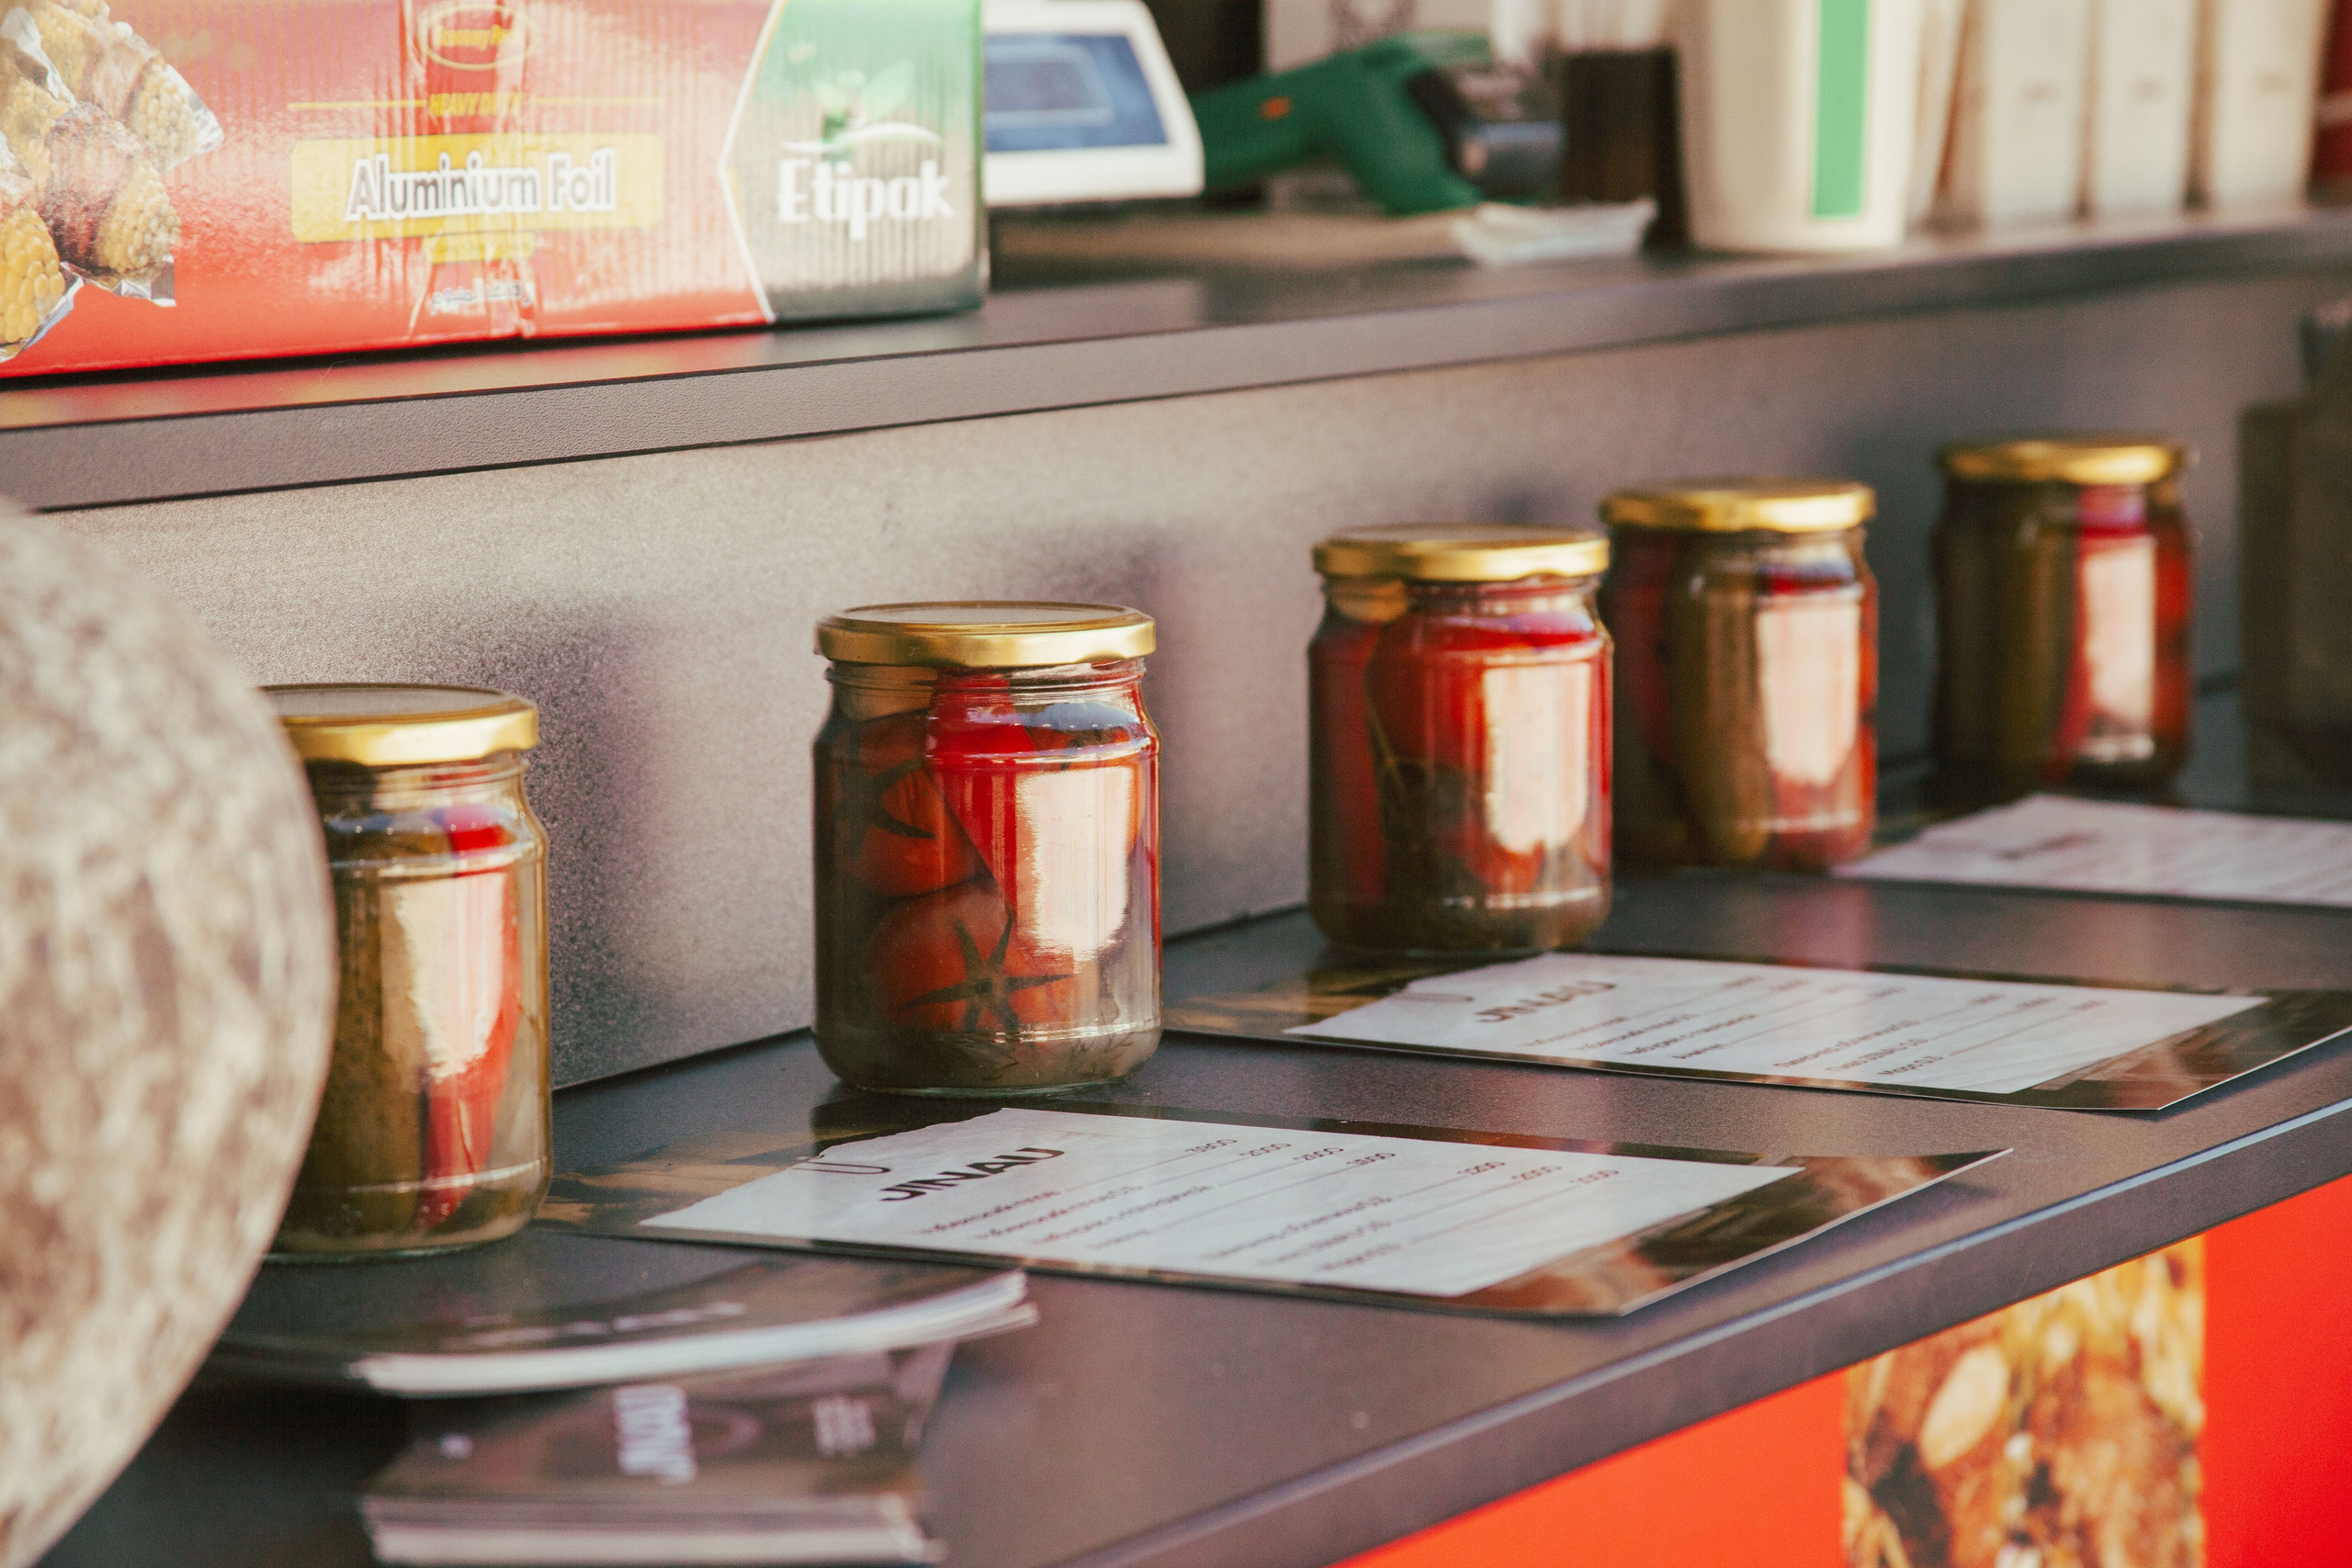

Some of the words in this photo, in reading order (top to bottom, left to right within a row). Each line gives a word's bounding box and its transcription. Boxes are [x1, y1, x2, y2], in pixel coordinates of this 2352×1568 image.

[345, 151, 541, 221] Aluminium
[548, 147, 616, 213] Foil
[778, 159, 955, 241] Etipak
[879, 1146, 1065, 1201] JINAU
